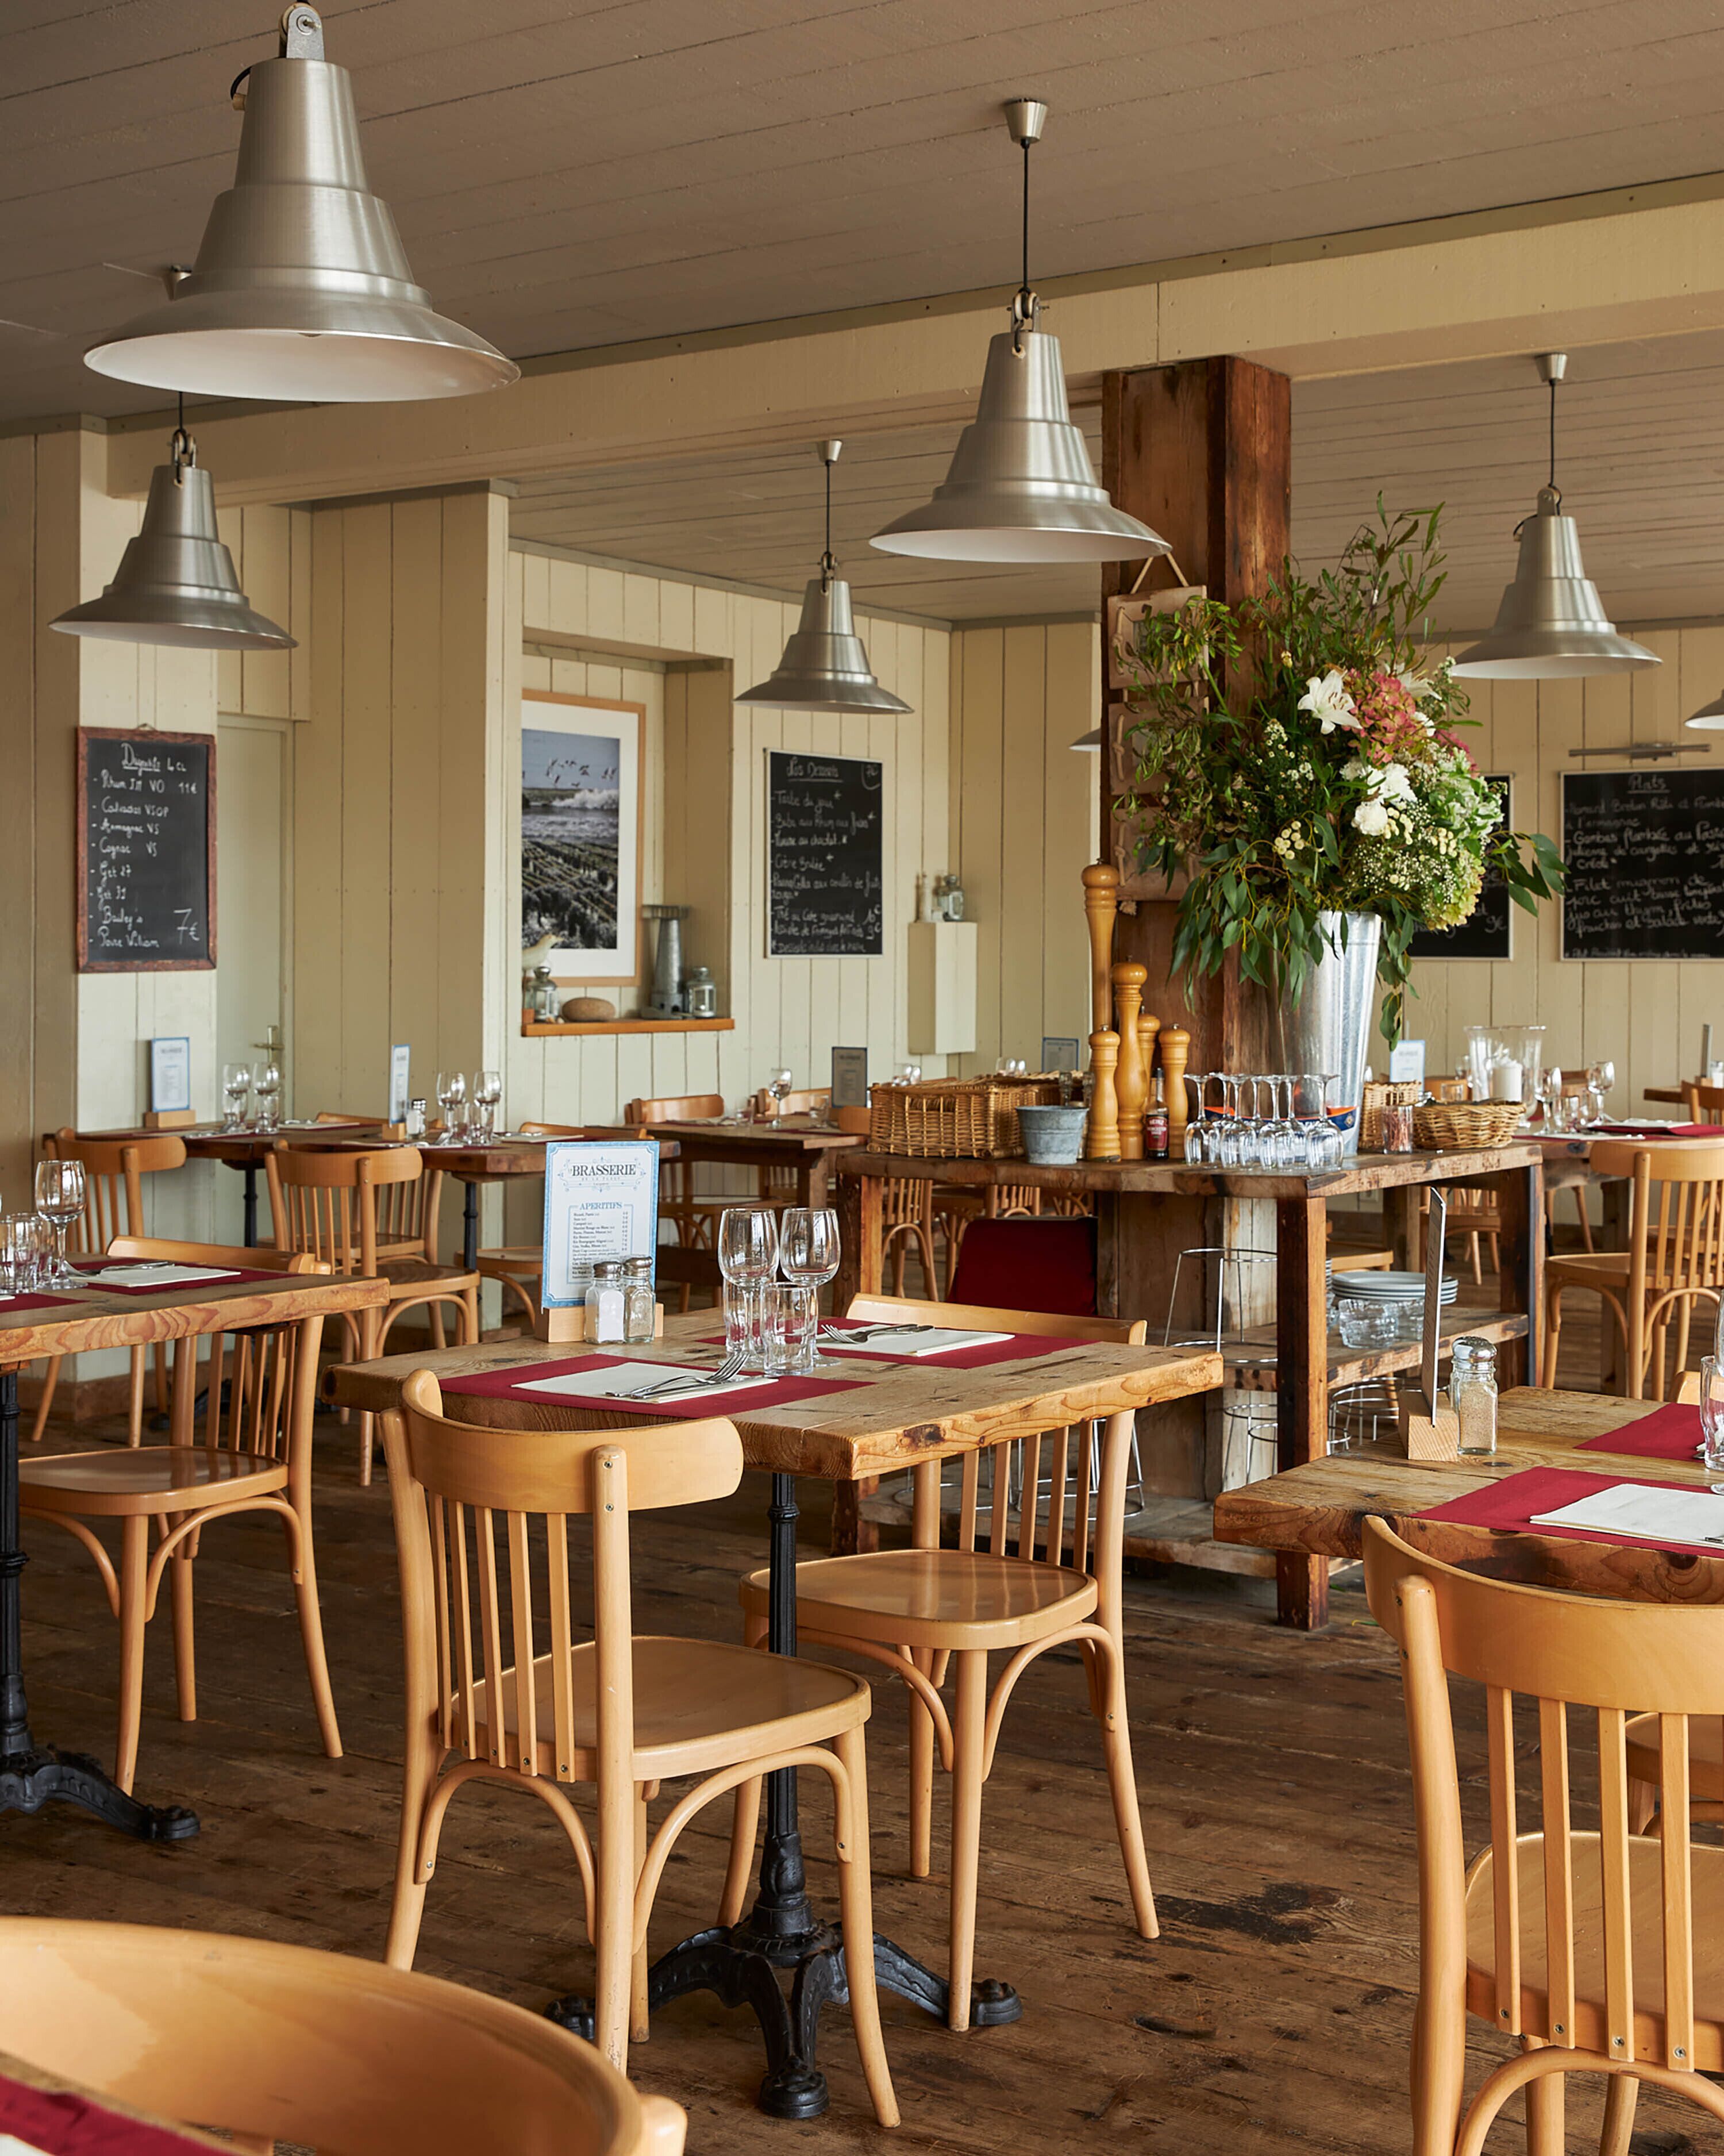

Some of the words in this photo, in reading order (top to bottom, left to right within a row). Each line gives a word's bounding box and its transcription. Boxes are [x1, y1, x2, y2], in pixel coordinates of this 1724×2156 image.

[101, 769, 126, 788] Rhum
[149, 779, 165, 794] VO
[178, 782, 198, 794] 11€
[101, 795, 141, 815] Calvados
[144, 804, 170, 817] VSOP
[803, 791, 814, 808] du
[147, 823, 160, 835] VS
[1572, 829, 1619, 846] Gambas
[1674, 831, 1693, 841] au
[99, 836, 132, 860] Cognac
[145, 841, 158, 858] VS
[99, 860, 117, 887] Get
[120, 864, 132, 878] 27
[1572, 877, 1610, 893] Filet
[1687, 873, 1710, 887] de
[1609, 888, 1642, 905] cuit
[1592, 908, 1619, 919] au
[1625, 914, 1642, 930] et
[572, 1163, 637, 1177] BRASSERIE
[580, 1202, 623, 1210] APERITIFS
